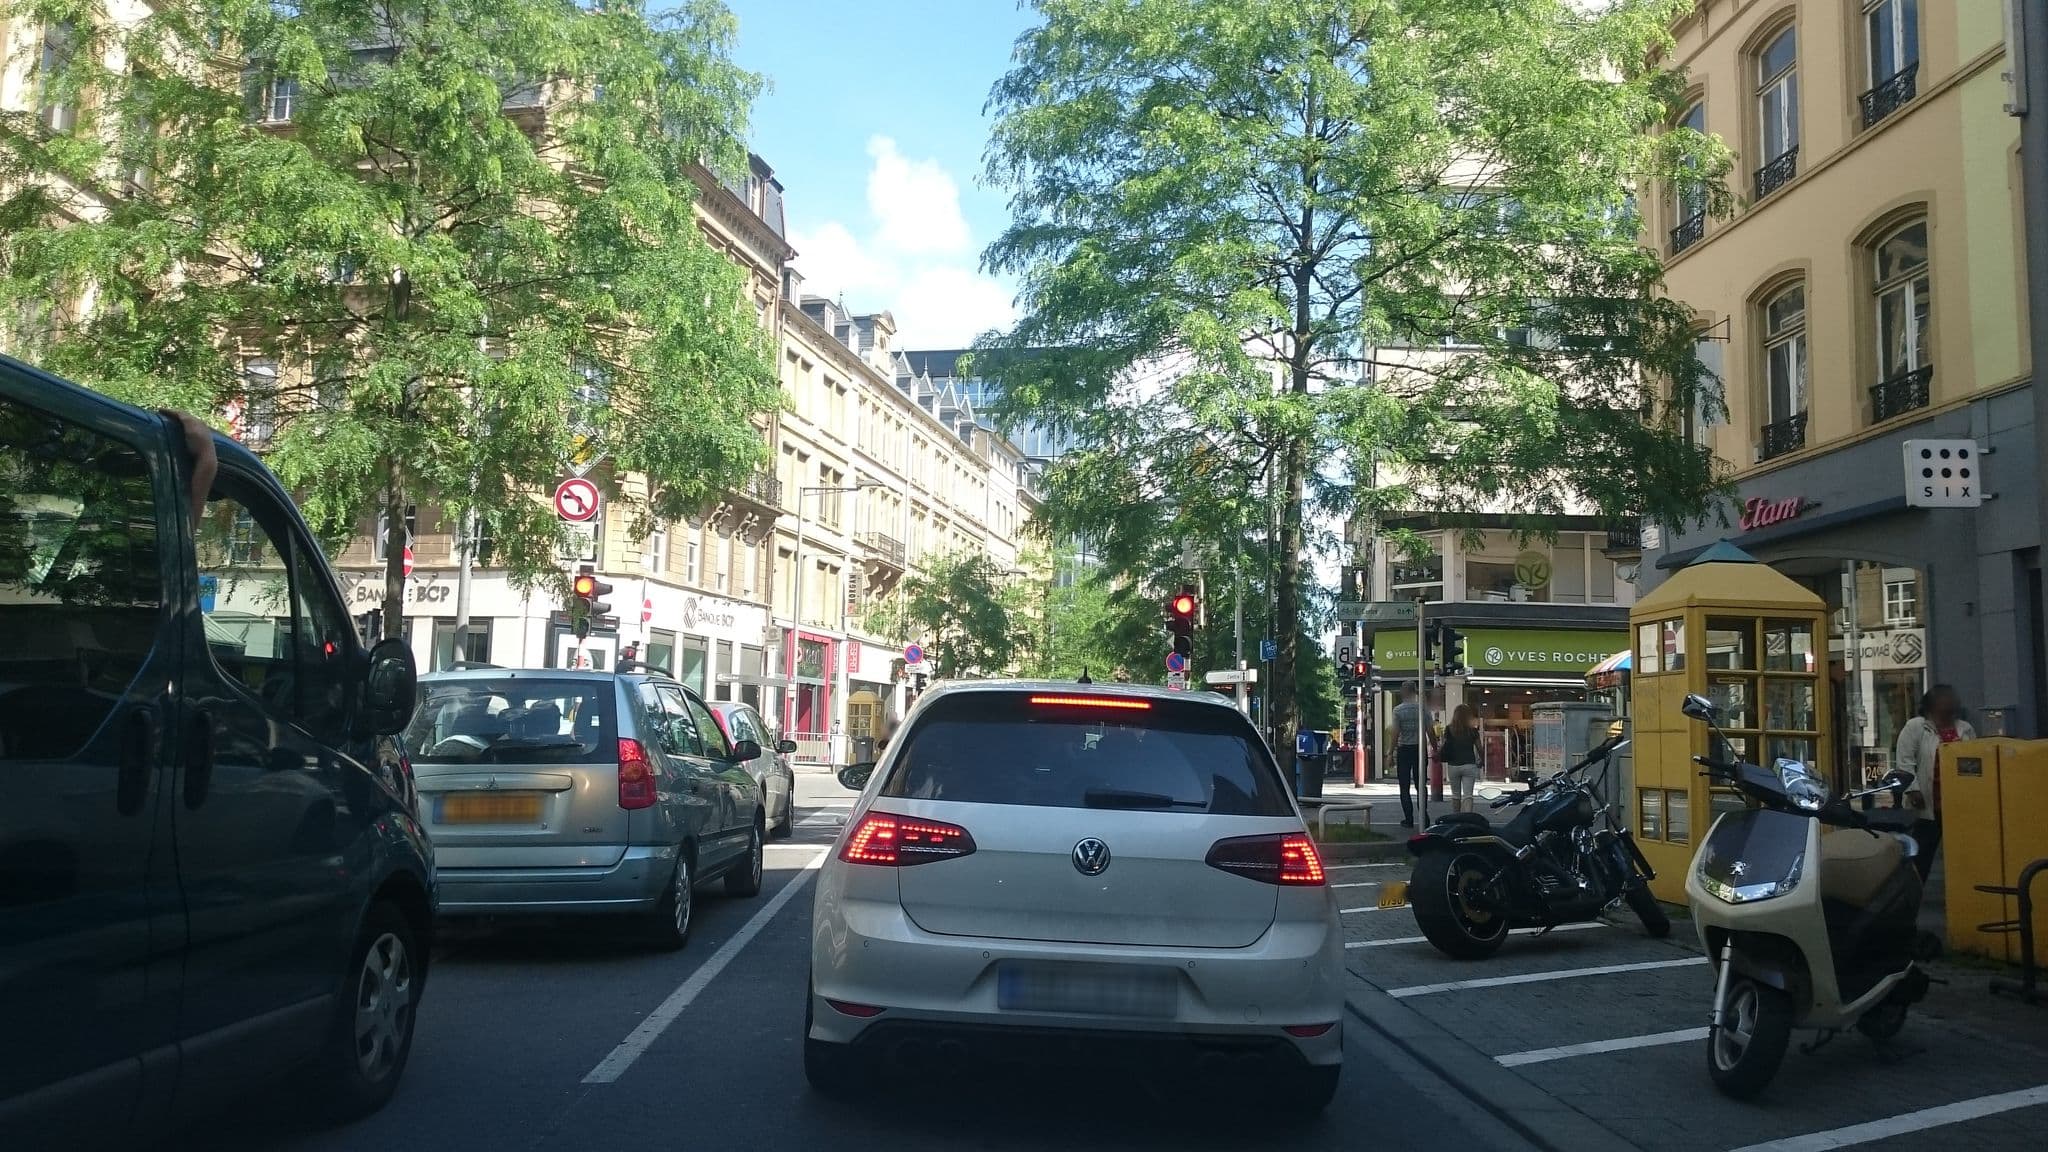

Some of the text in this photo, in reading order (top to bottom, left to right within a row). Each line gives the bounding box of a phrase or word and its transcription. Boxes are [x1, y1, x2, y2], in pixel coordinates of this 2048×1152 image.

[1924, 486, 1971, 498] SIX
[1739, 497, 1800, 530] Etam
[416, 586, 450, 602] BCP
[1507, 651, 1547, 662] YVES
